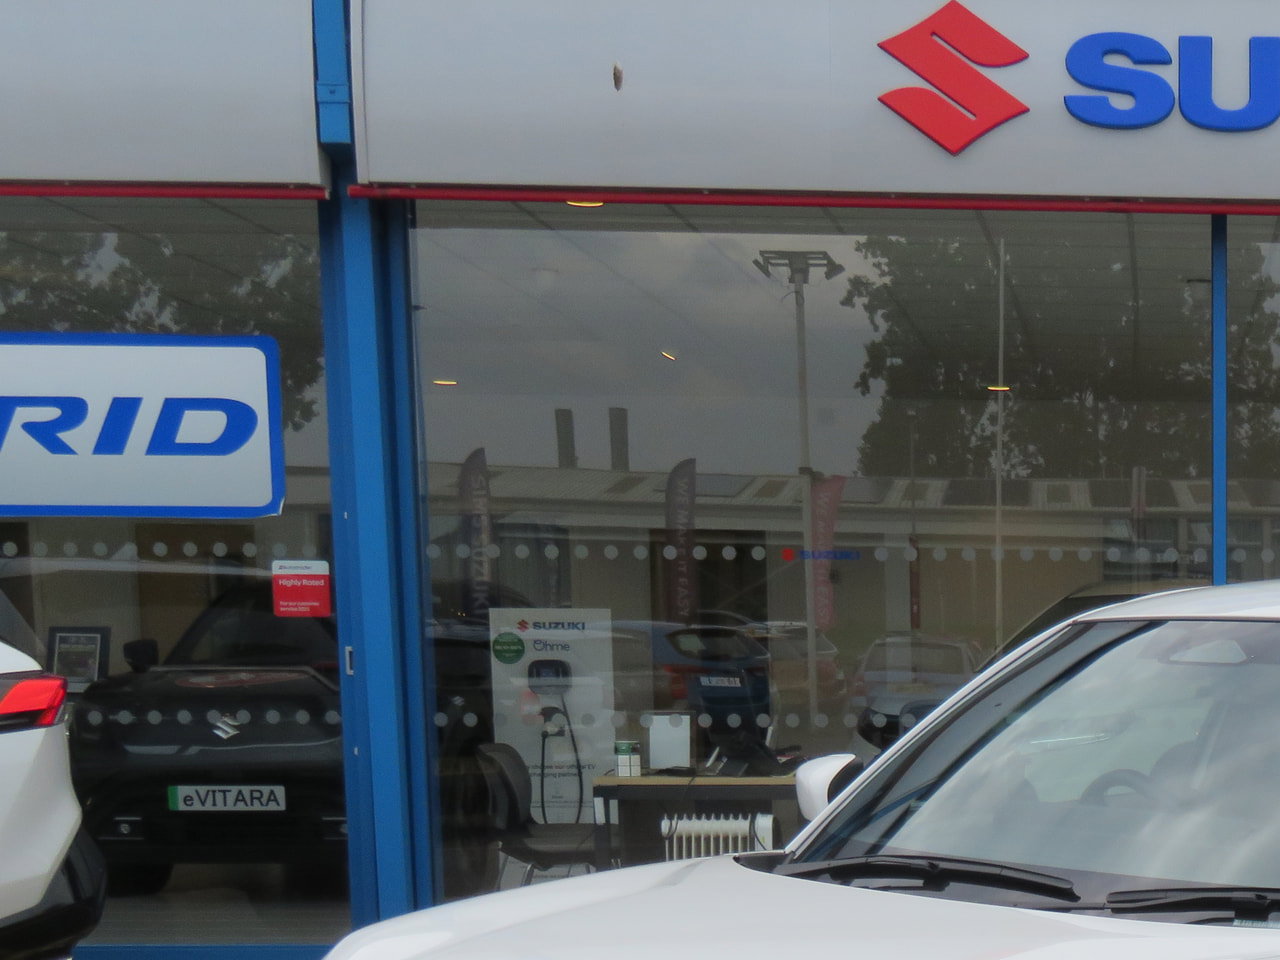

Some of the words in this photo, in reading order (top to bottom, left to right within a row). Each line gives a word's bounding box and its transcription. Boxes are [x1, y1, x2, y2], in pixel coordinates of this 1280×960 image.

[279, 579, 301, 587] Highly
[532, 621, 585, 631] SUZUKI
[533, 639, 570, 651] Ohme
[183, 789, 280, 807] eVITARA
